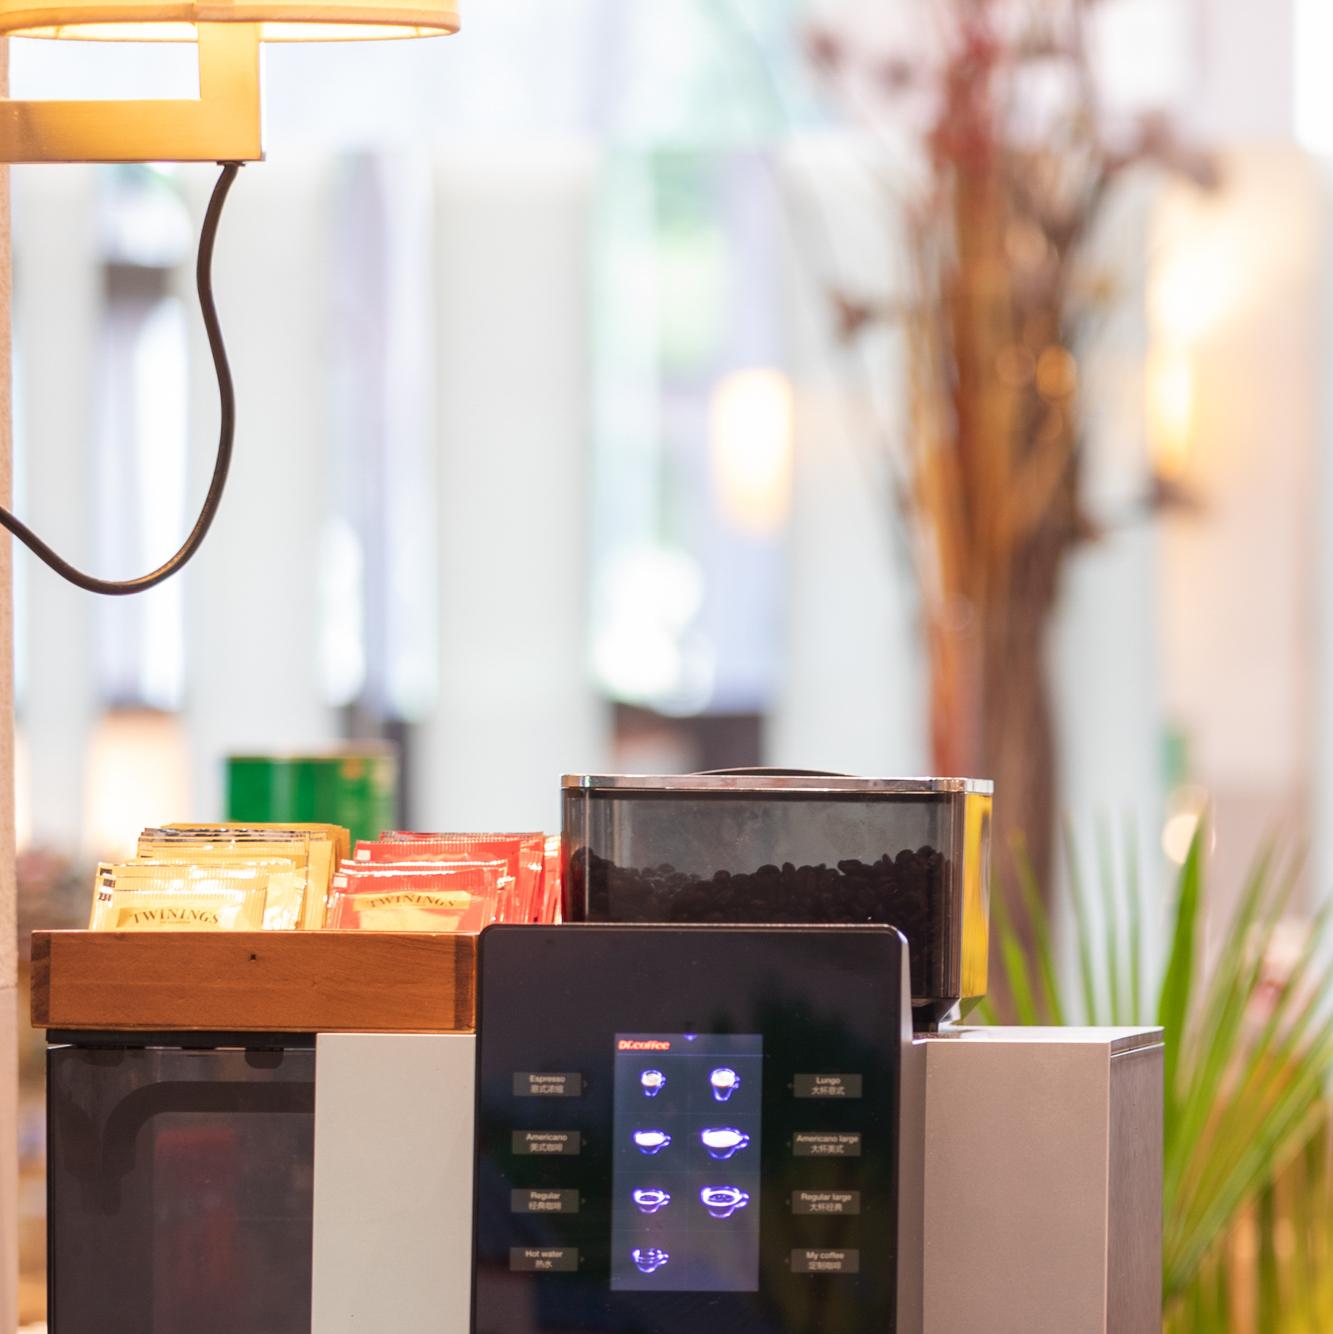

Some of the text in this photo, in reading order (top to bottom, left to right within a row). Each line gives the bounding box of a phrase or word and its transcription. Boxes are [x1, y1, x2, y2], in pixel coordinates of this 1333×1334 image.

[369, 895, 457, 907] TWININGS
[128, 907, 219, 924] TWININGS
[529, 1075, 566, 1083] Espresso
[816, 1077, 841, 1085] Lungo
[526, 1133, 568, 1141] Americano
[796, 1134, 859, 1144] Americano large
[530, 1192, 560, 1201] Regular
[800, 1193, 852, 1203] Regular large
[525, 1250, 563, 1258] Hot water
[806, 1252, 818, 1260] My
